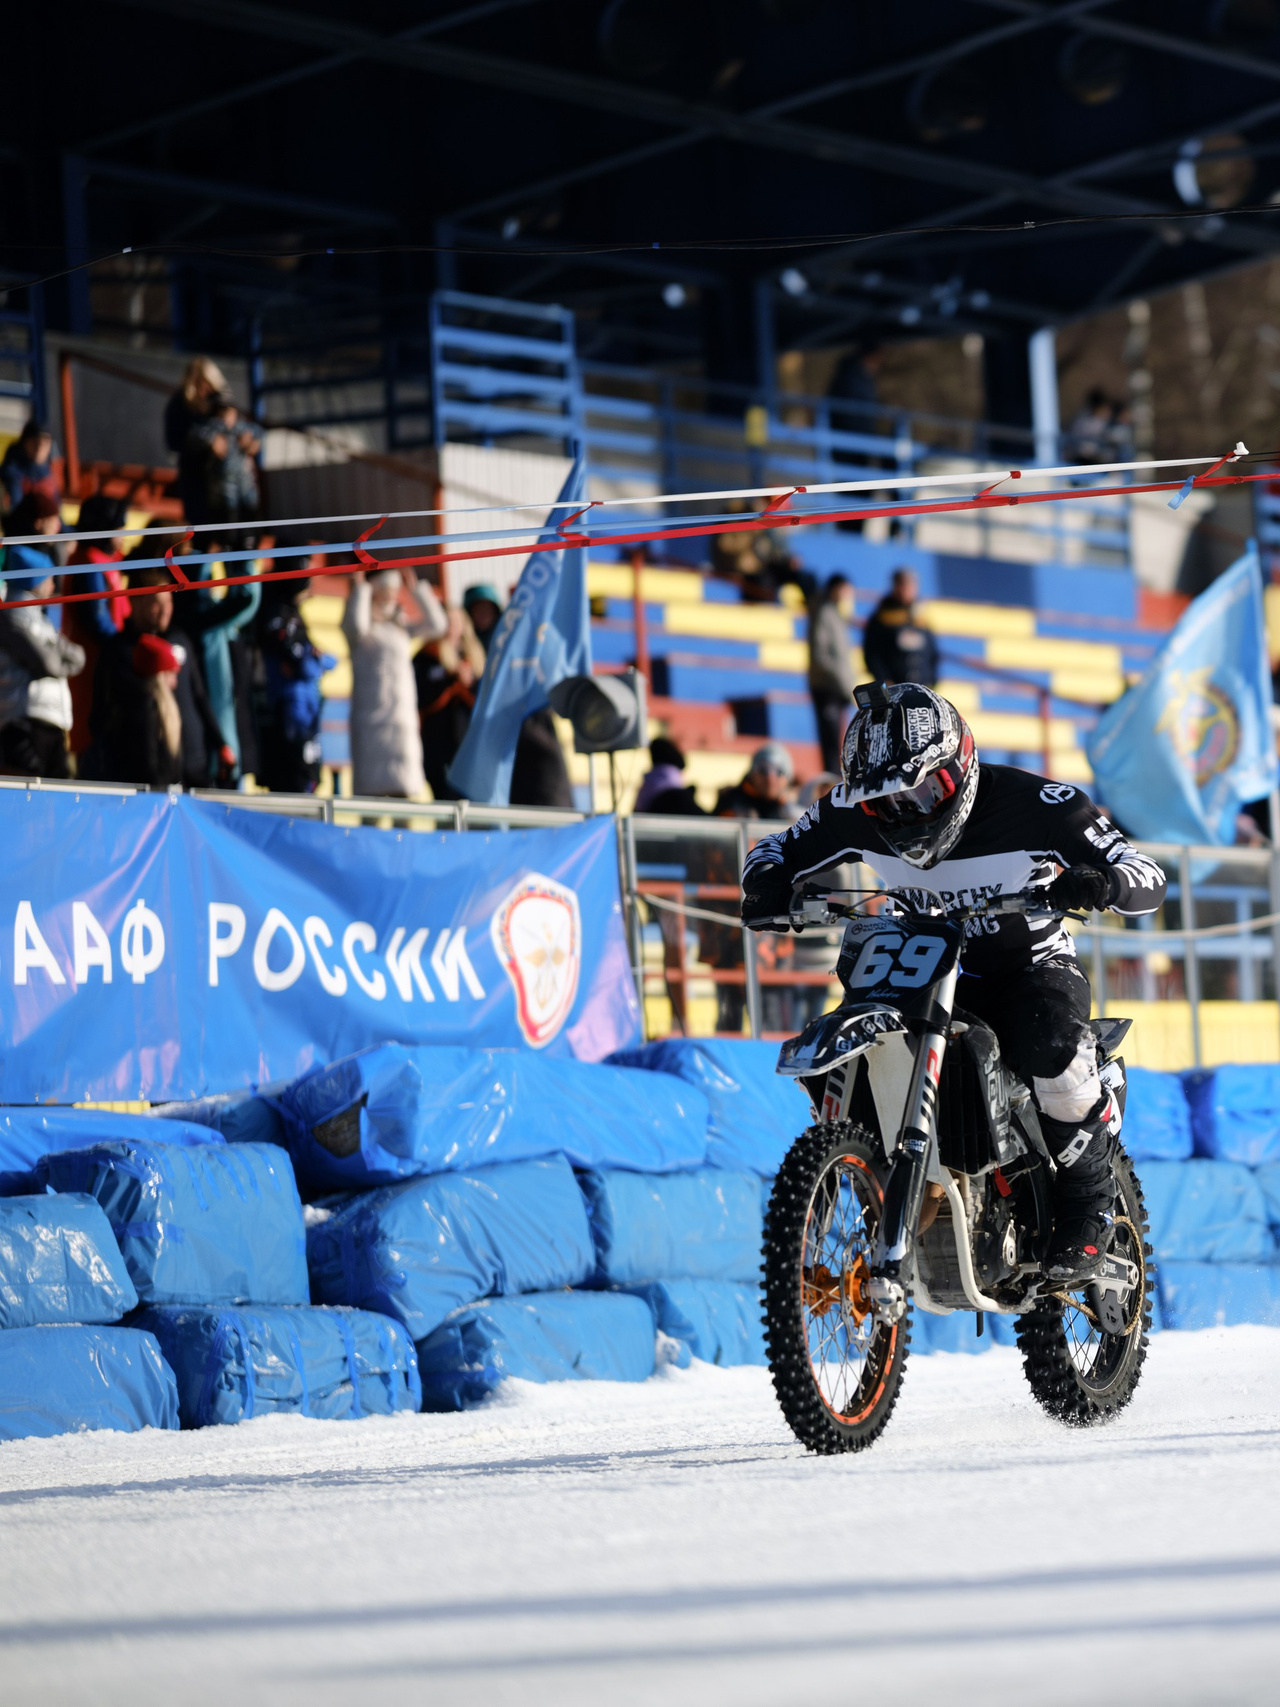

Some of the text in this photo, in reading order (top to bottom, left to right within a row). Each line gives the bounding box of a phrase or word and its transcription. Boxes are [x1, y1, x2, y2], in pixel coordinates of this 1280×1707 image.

[908, 708, 919, 750] ANARCHY
[13, 898, 165, 985] ААФ
[208, 902, 486, 1002] РОССИИ
[848, 934, 948, 989] 69
[1057, 1128, 1094, 1168] SIDI
